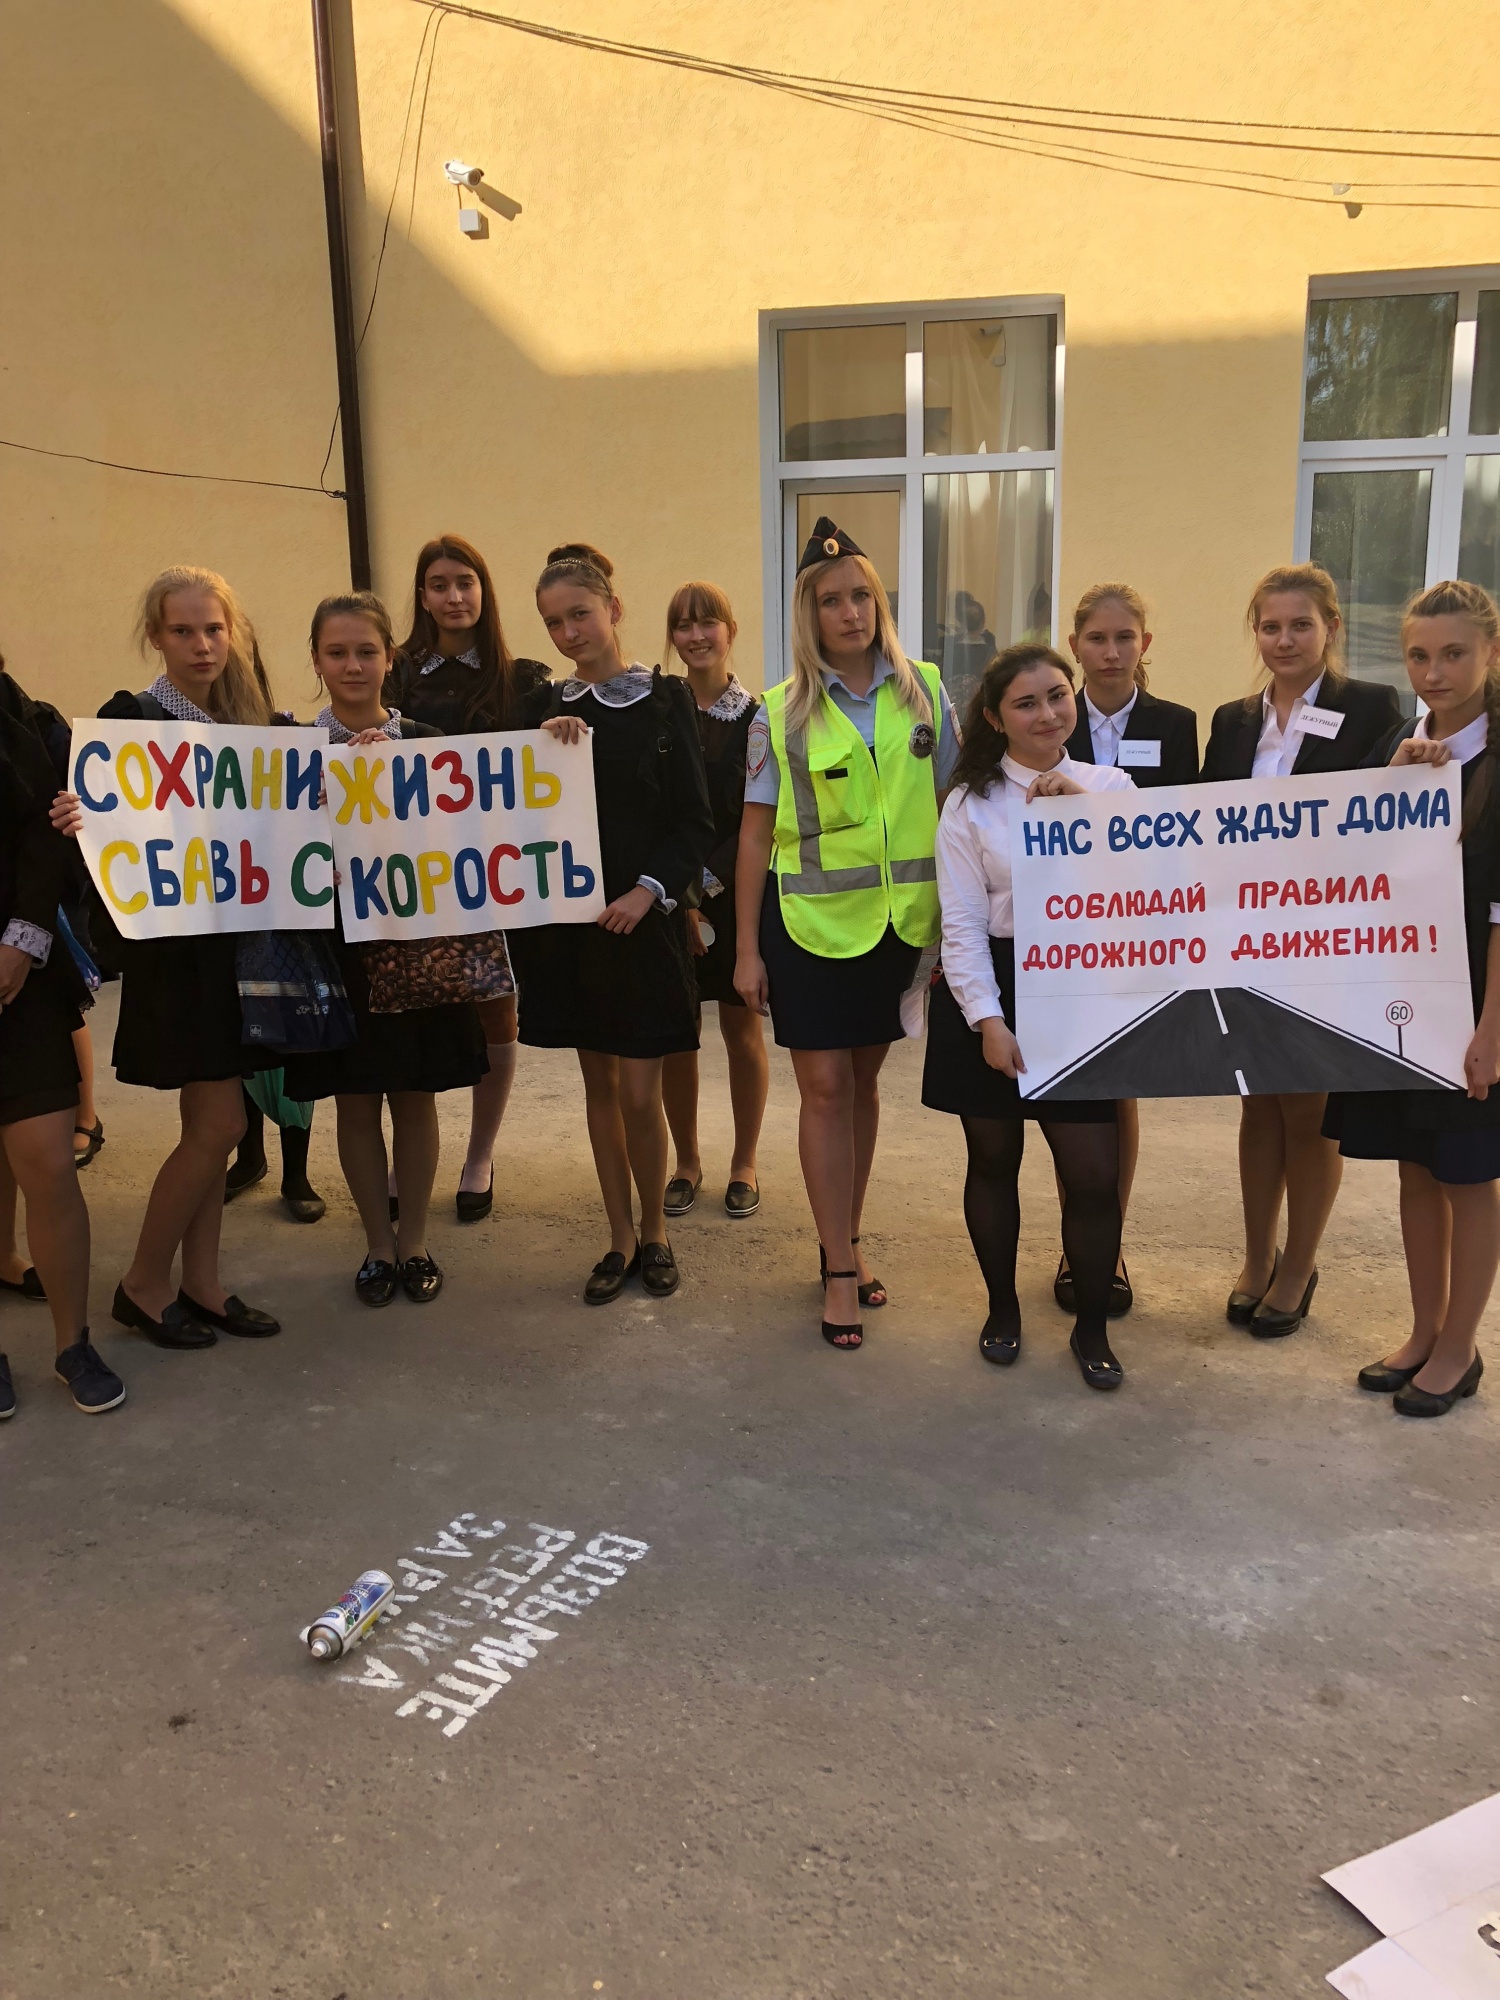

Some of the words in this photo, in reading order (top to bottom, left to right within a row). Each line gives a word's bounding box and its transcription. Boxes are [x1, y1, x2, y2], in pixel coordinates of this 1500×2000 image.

[74, 740, 323, 812] СОХРАНИ
[328, 744, 563, 826] ЖИЗНЬ
[1022, 818, 1092, 857] НАС
[1216, 799, 1329, 845] ЖДУТ
[1337, 787, 1451, 836] ДОМА
[98, 837, 270, 915] СБАВЬ
[1045, 882, 1206, 921] СОБЛЮДАЙ
[1238, 873, 1391, 910] ПРАВИЛА
[1022, 937, 1207, 972] ДОРОЖНОГО
[1390, 1005, 1408, 1021] 60
